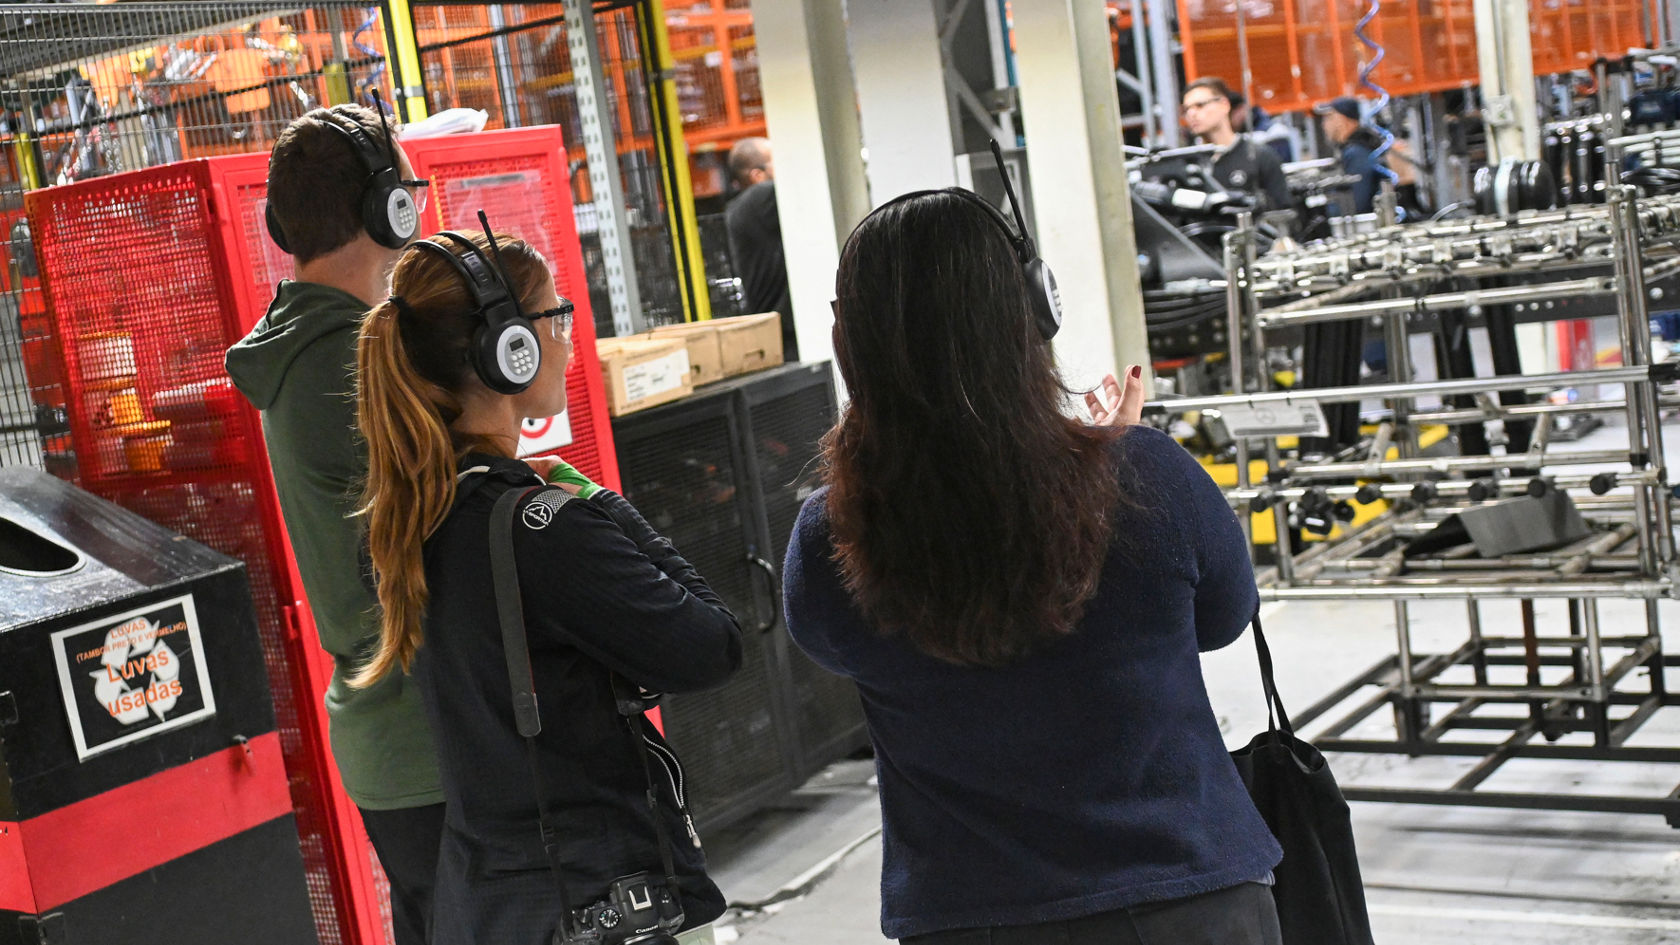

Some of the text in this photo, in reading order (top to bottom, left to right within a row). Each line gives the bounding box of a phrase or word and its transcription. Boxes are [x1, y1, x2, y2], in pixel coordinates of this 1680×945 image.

[109, 619, 146, 639] LUVAS
[76, 644, 111, 664] (TAMBOR
[112, 637, 137, 652] PRETO
[106, 650, 169, 683] Luvas
[108, 679, 183, 717] usadas
[636, 925, 659, 933] Canon
